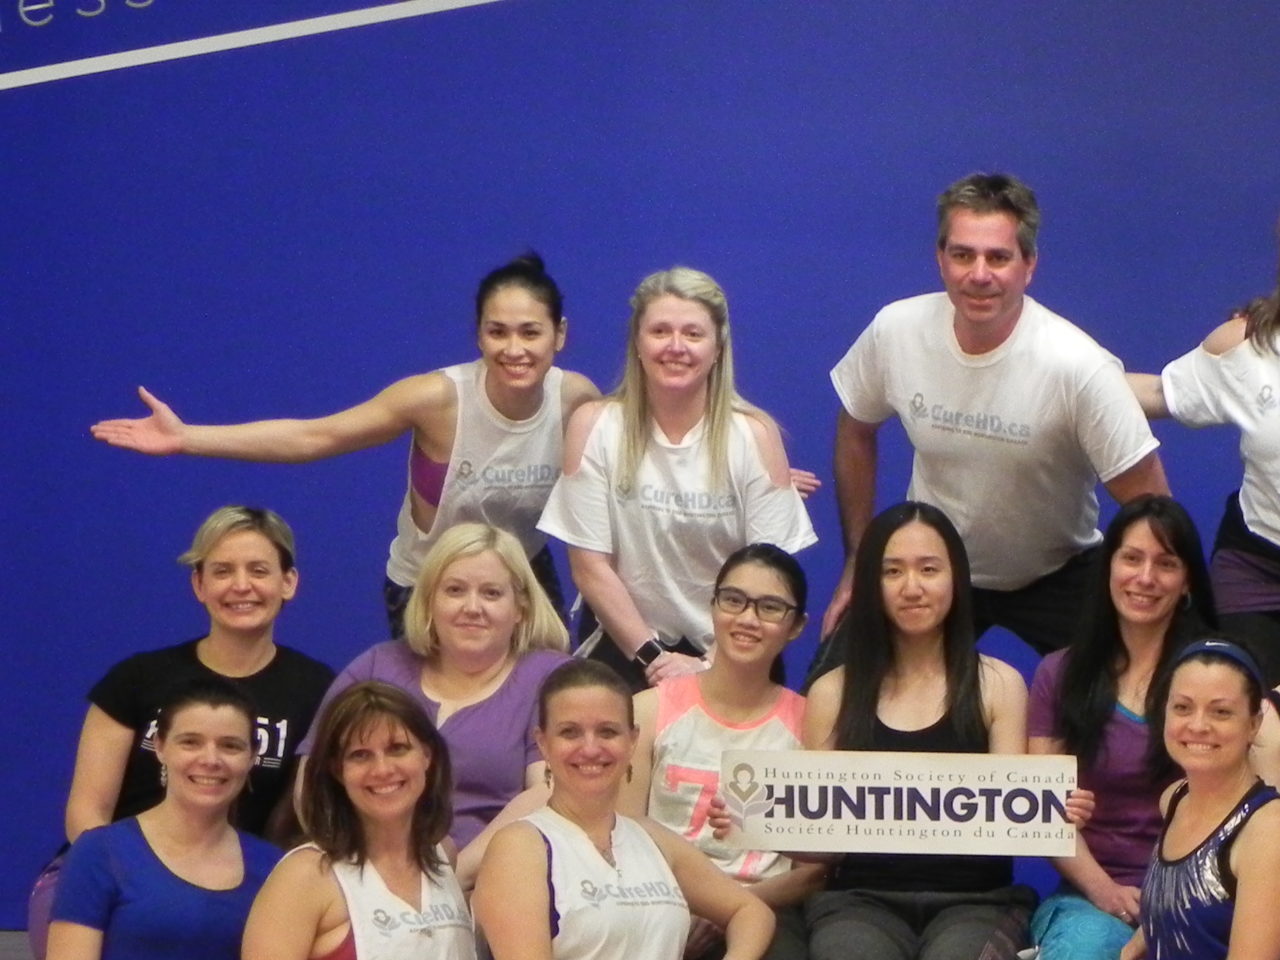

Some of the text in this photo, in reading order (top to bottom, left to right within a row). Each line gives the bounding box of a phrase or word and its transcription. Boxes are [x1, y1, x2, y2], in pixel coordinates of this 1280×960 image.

[931, 404, 1031, 437] CureHD.ca
[641, 484, 737, 510] CureHD.ca
[764, 767, 1075, 785] Huntington Society of Canada
[764, 785, 1074, 824] HUNTINGTON
[764, 822, 1075, 840] Société Huntington du Canada
